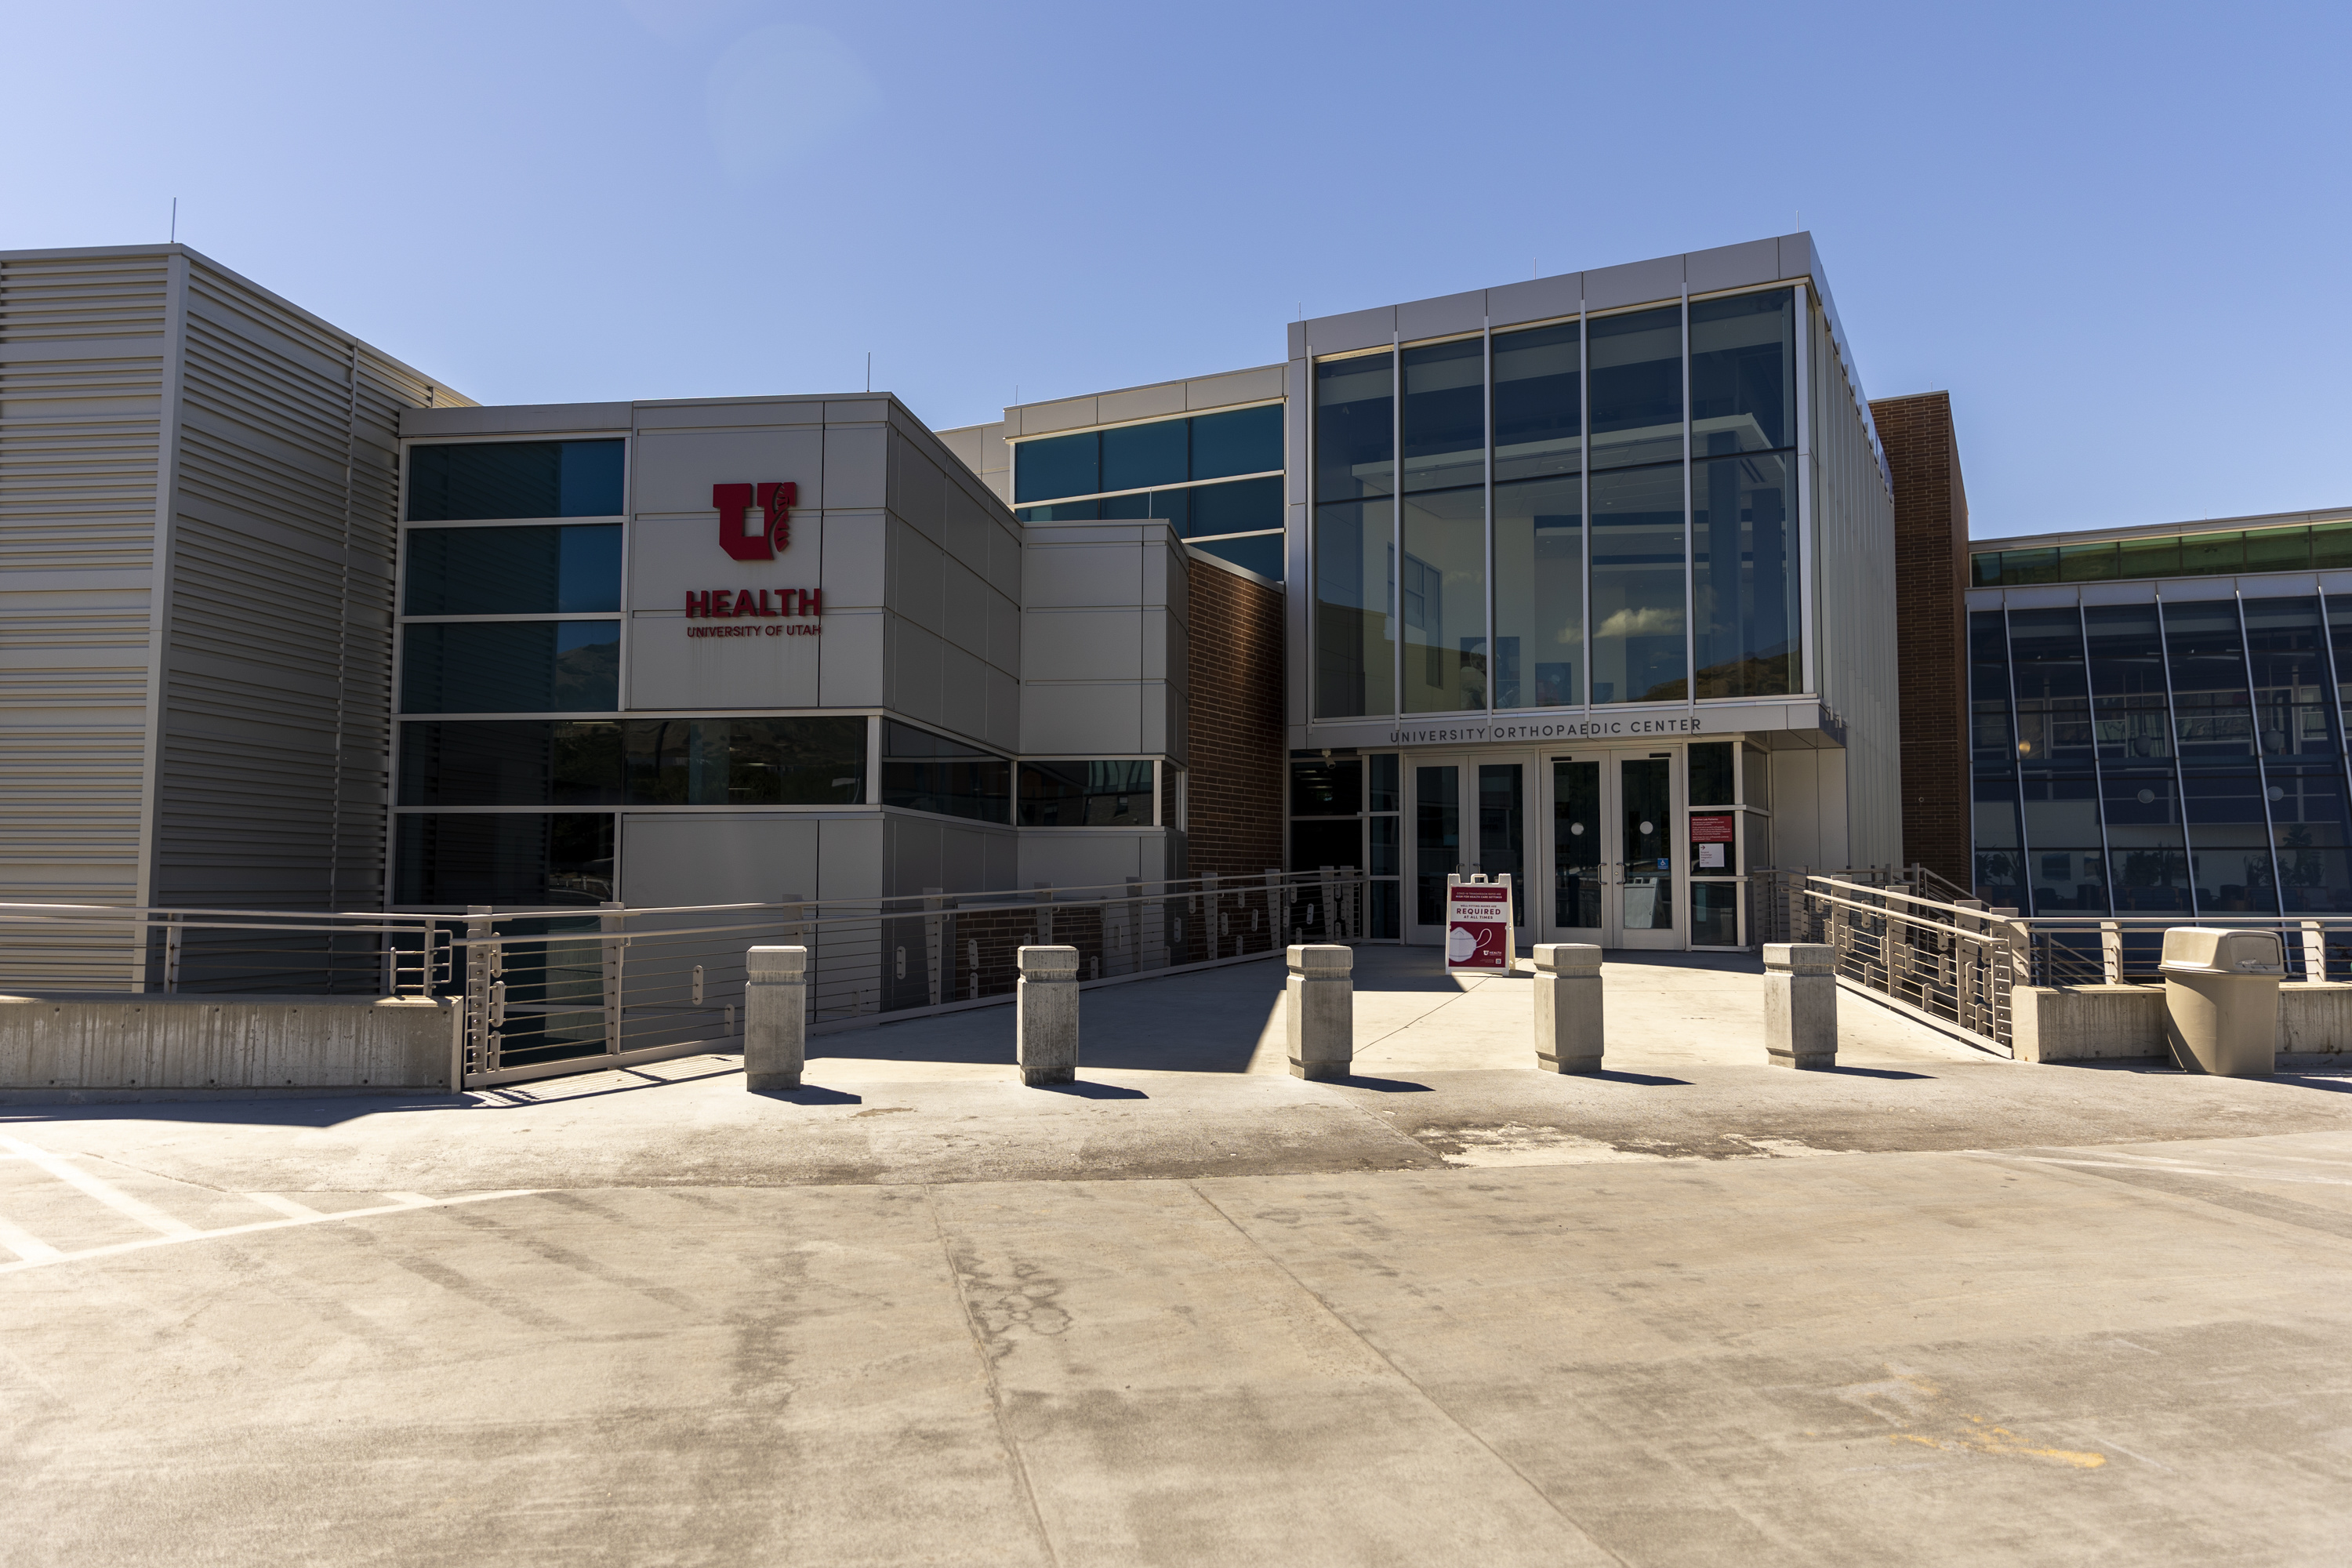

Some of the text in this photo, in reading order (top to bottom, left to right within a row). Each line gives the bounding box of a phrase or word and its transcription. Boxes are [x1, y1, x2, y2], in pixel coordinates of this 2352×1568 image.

[685, 588, 821, 618] HEALTH
[687, 624, 822, 637] UNIVERSITY OF UTAH
[1389, 718, 1702, 743] UNIVERSITY ORTHOPAEDIC CENTER
